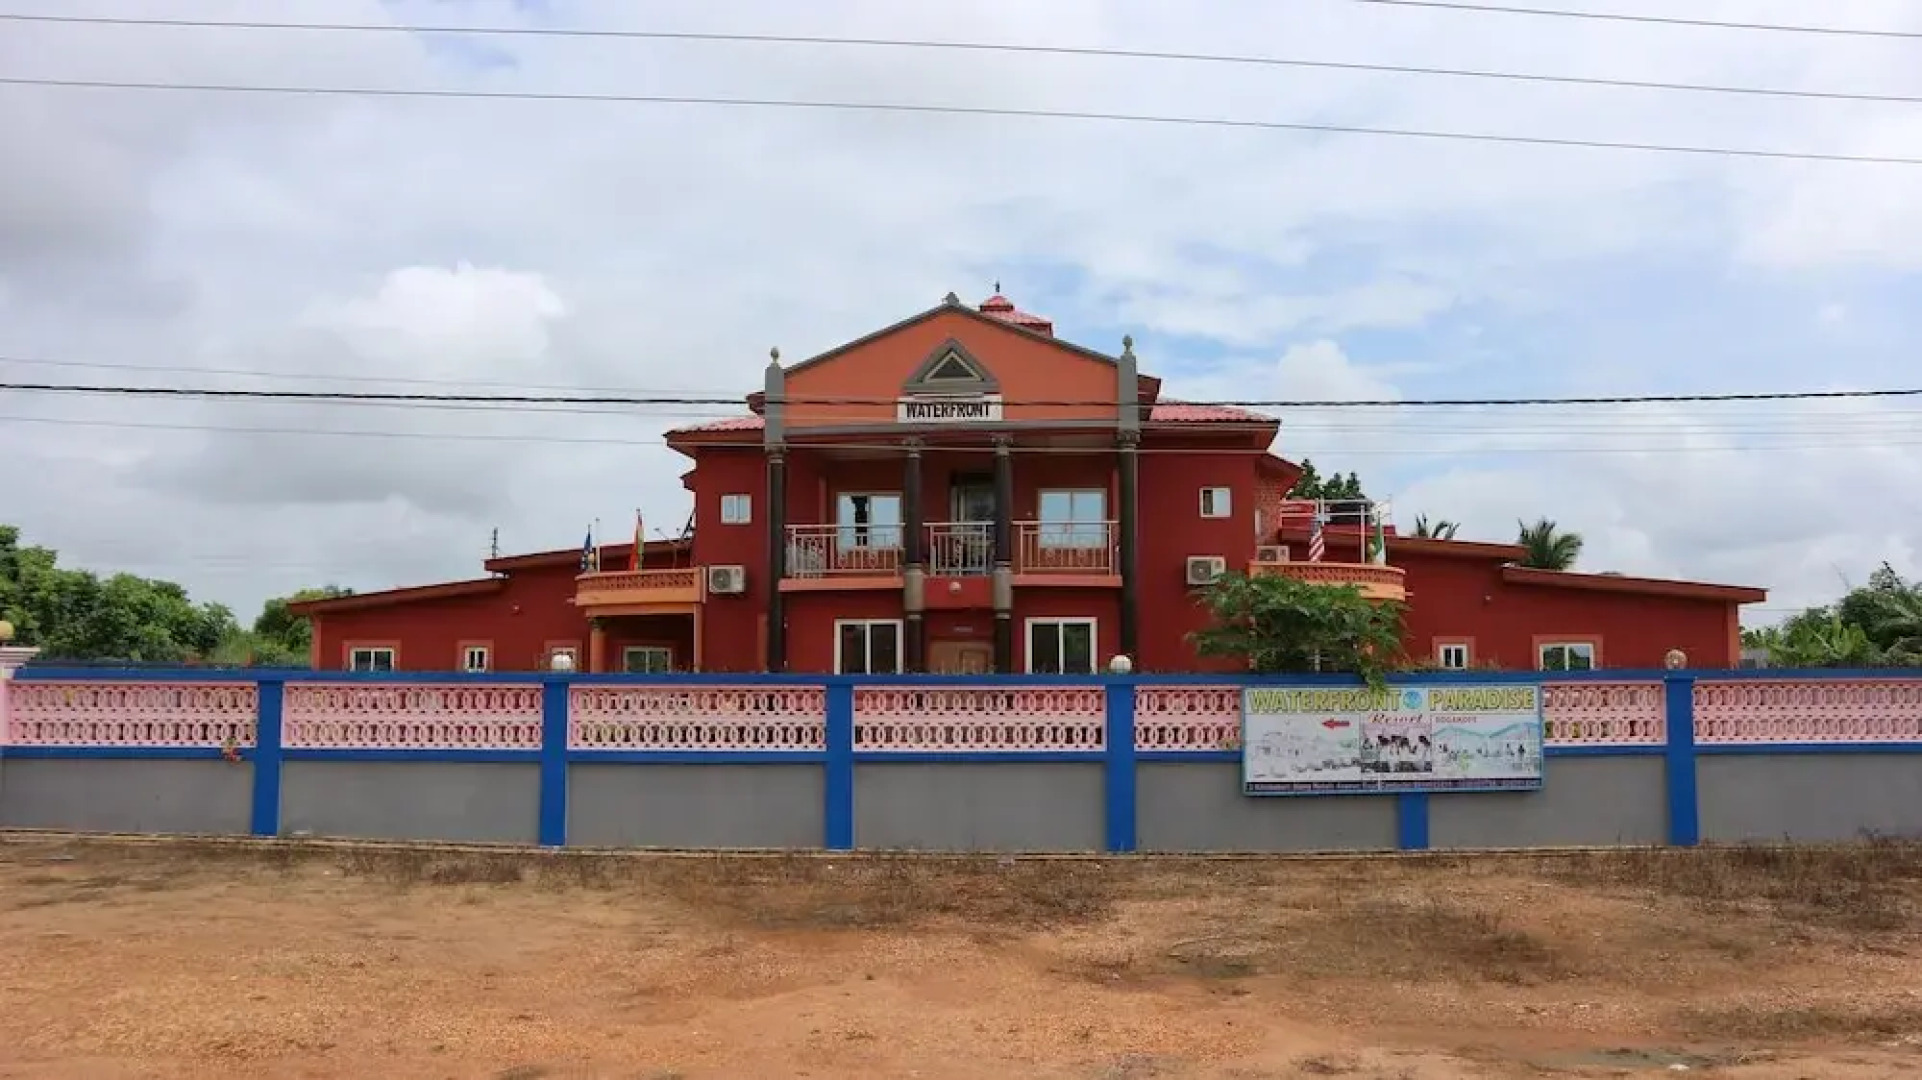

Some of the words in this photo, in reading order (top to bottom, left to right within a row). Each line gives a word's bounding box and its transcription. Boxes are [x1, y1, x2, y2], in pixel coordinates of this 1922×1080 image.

[906, 402, 991, 417] WATERFRONT
[1250, 689, 1401, 713] WATERFRONT
[1429, 689, 1535, 710] PARADISE
